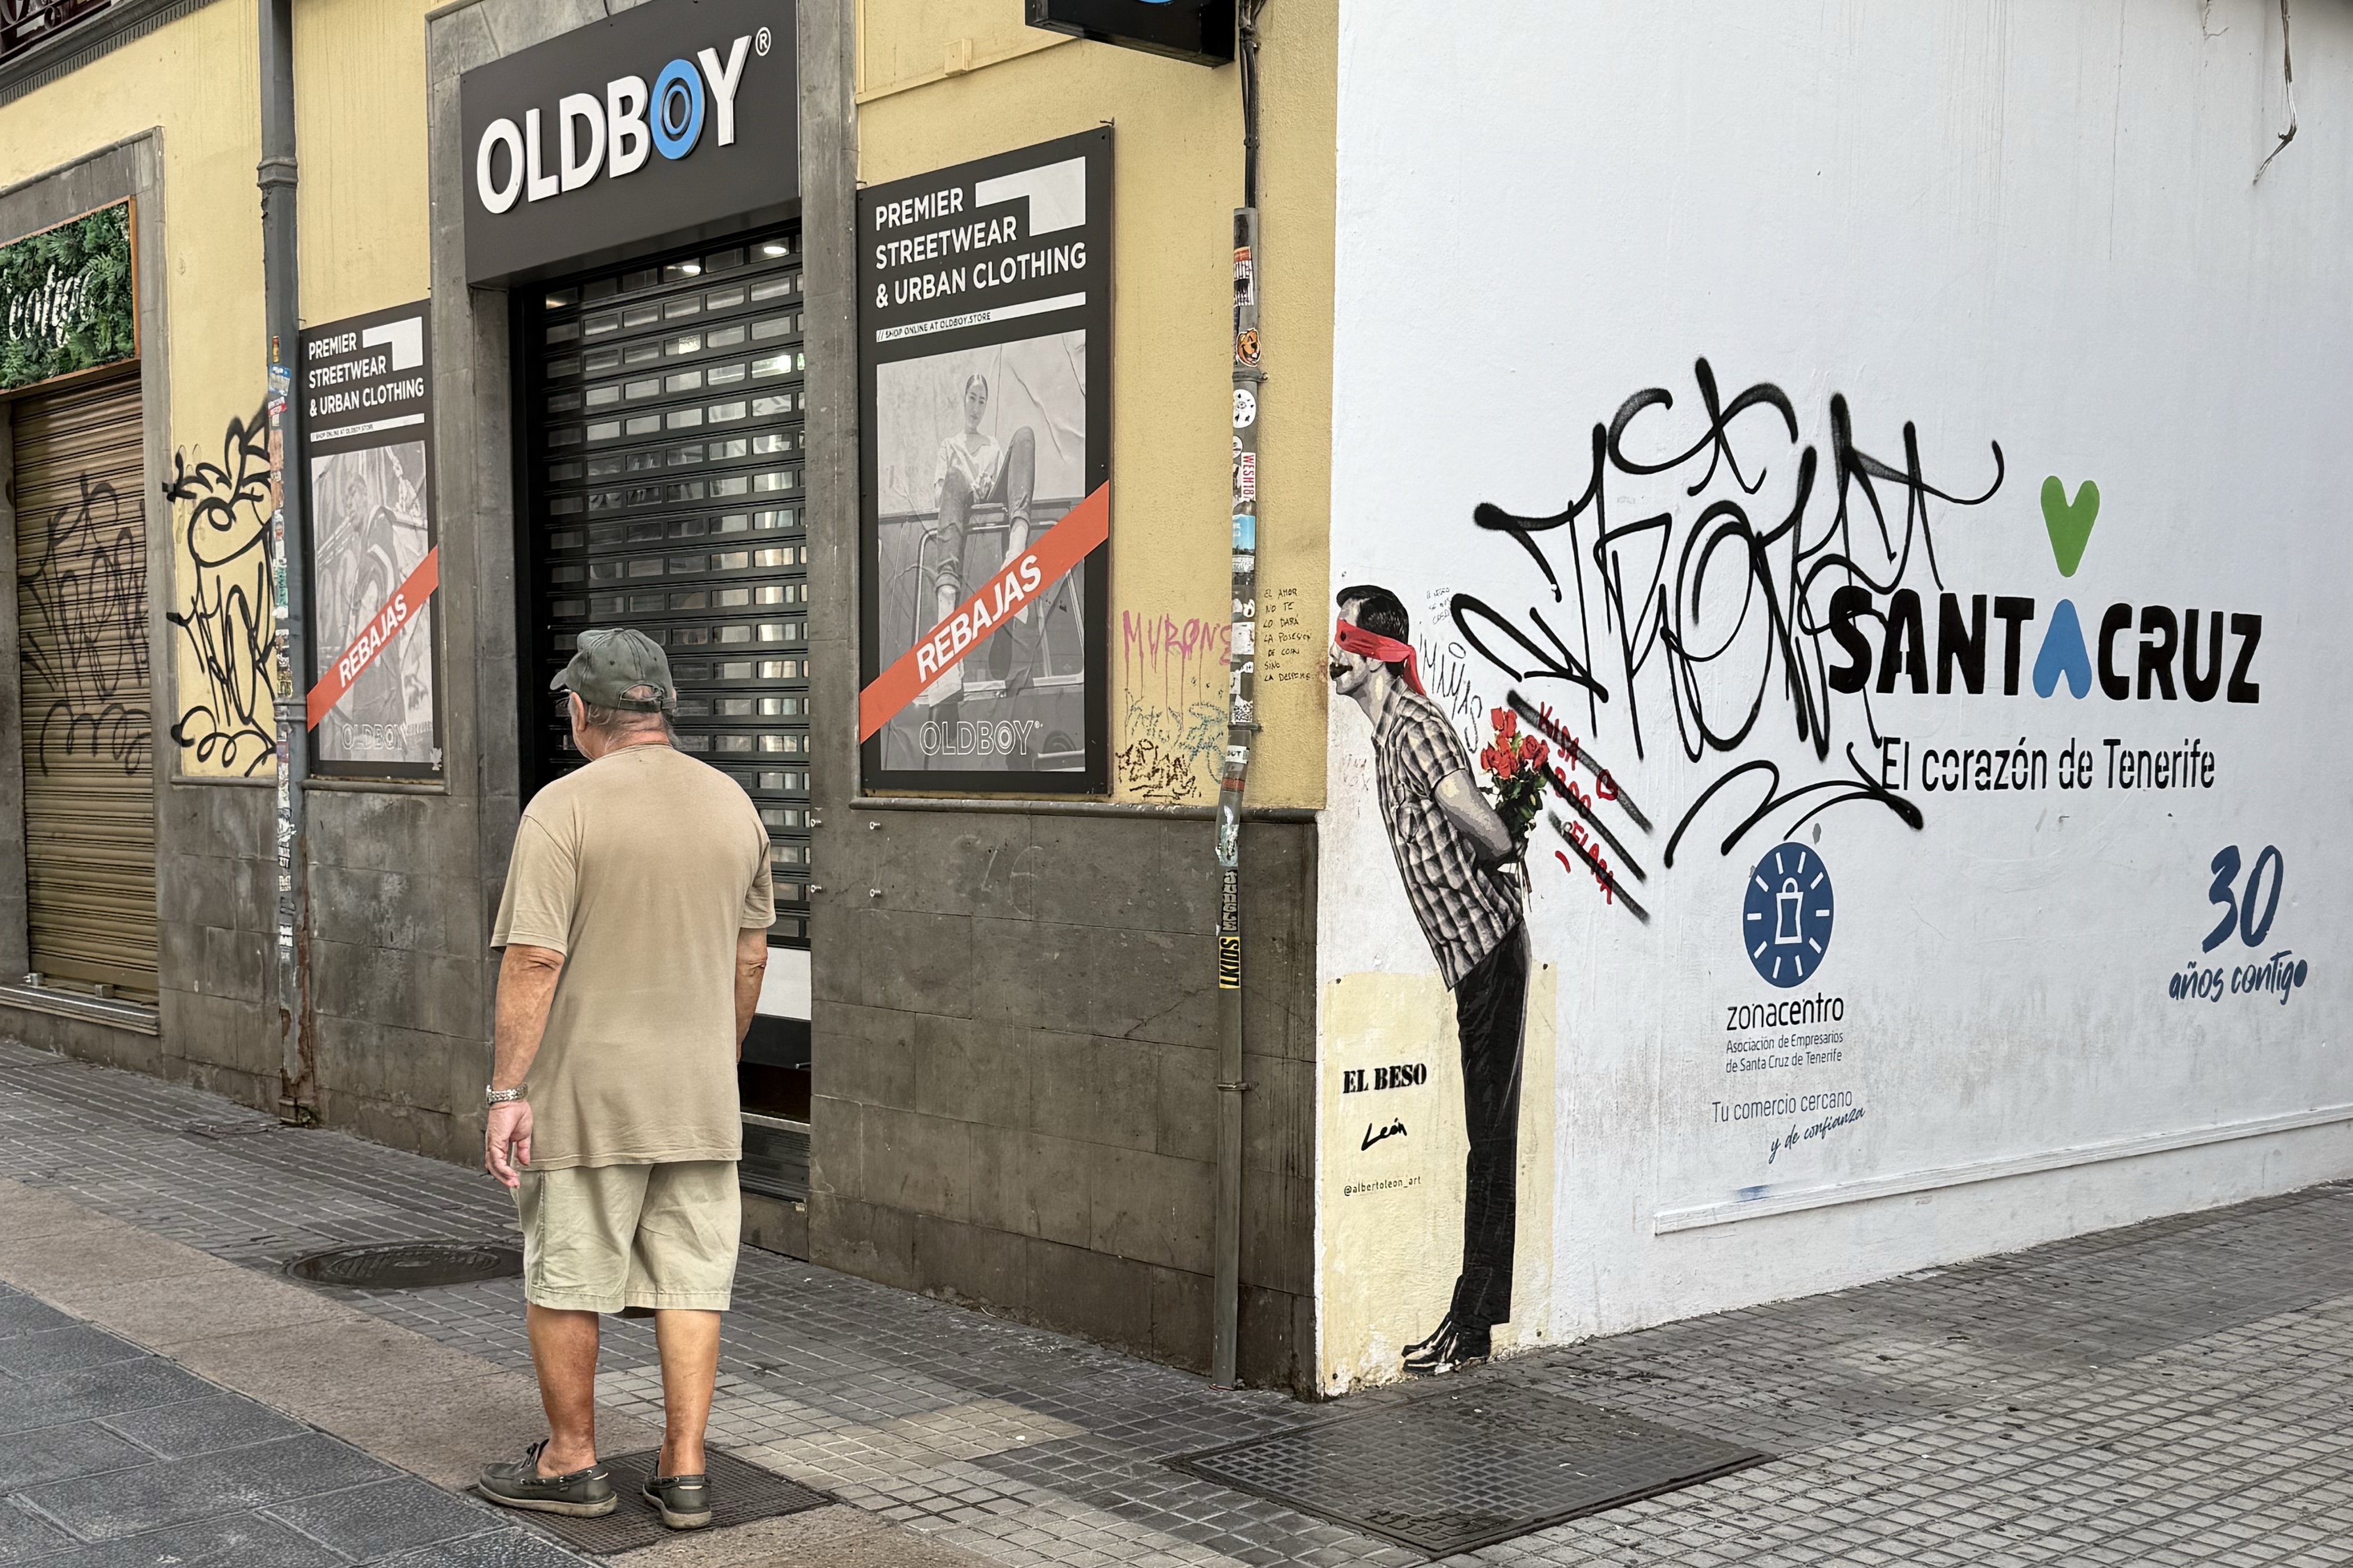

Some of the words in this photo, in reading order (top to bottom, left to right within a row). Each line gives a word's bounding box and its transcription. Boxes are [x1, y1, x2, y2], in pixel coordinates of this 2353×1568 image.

[875, 187, 963, 231] PREMIER
[876, 215, 1017, 270] STREETWEAR
[875, 283, 889, 308] &
[894, 267, 966, 304] URBAN
[973, 242, 1087, 289] CLOTHING
[904, 323, 928, 335] ONLINE
[930, 322, 938, 330] AT
[309, 332, 357, 360] PREMIER
[309, 355, 386, 389] STREETWEAR
[310, 399, 317, 417] &
[319, 390, 359, 415] URBAN
[362, 378, 424, 407] CLOTHING
[1264, 589, 1272, 598] EL
[1265, 604, 1276, 614] NO
[914, 554, 1042, 683] REBAJAS
[1263, 619, 1273, 628] LO
[338, 593, 407, 688] REBAJAS
[1264, 633, 1273, 644] LA
[1881, 736, 1909, 792] El
[1921, 736, 2047, 792] corazón
[2059, 737, 2093, 790] de
[2103, 738, 2216, 790] Tenerife
[2202, 844, 2284, 954] 30
[2169, 961, 2224, 1003] años
[2231, 950, 2308, 1006] contigo
[1726, 993, 1844, 1031] zonacentro
[1726, 1036, 1774, 1054] Asociación
[1778, 1034, 1789, 1049] de
[1791, 1030, 1843, 1049] Empresarios
[1726, 1059, 1738, 1073] de
[1740, 1057, 1766, 1072] Santa
[1769, 1055, 1789, 1069] Cruz
[1792, 1052, 1803, 1066] de
[1806, 1048, 1843, 1065] Tenerife
[1342, 1069, 1369, 1094] EL
[1373, 1063, 1427, 1090] BESO
[1712, 1101, 1729, 1123] Tu
[1733, 1093, 1796, 1121] comercio
[1800, 1090, 1853, 1112] cercano
[1768, 1138, 1781, 1165] y
[1784, 1124, 1800, 1150] de
[1803, 1106, 1866, 1140] confianza
[1343, 1175, 1422, 1197] @albertoleon_art
